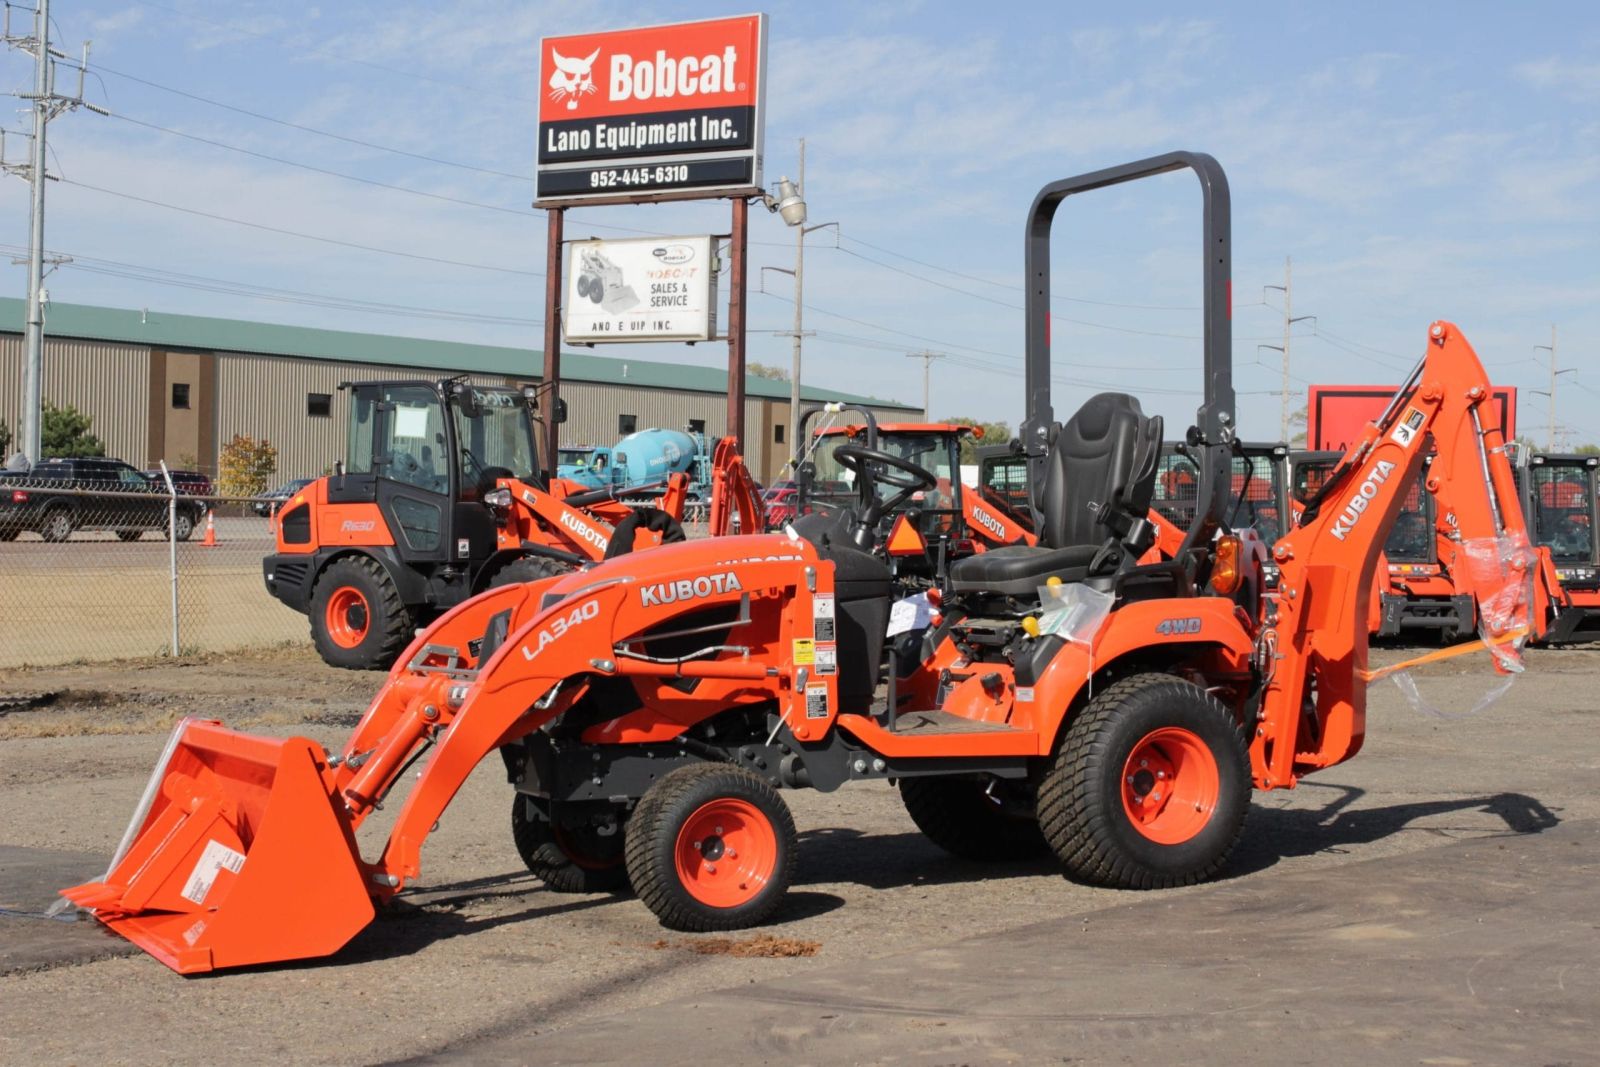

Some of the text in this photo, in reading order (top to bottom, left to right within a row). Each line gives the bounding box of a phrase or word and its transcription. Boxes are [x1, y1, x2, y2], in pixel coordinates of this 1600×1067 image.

[609, 45, 737, 101] Bobcat
[548, 116, 738, 152] Lano Equipment Inc.
[590, 165, 688, 187] 952-445-6310
[650, 283, 688, 294] SALES &
[650, 295, 688, 307] SERVICE
[1330, 460, 1397, 541] KUBOTA
[560, 511, 609, 553] KUBOTA
[972, 505, 1005, 540] KUBOTA
[640, 571, 742, 607] KUBOTA
[521, 599, 599, 661] LA340
[1155, 617, 1201, 636] 4WD
